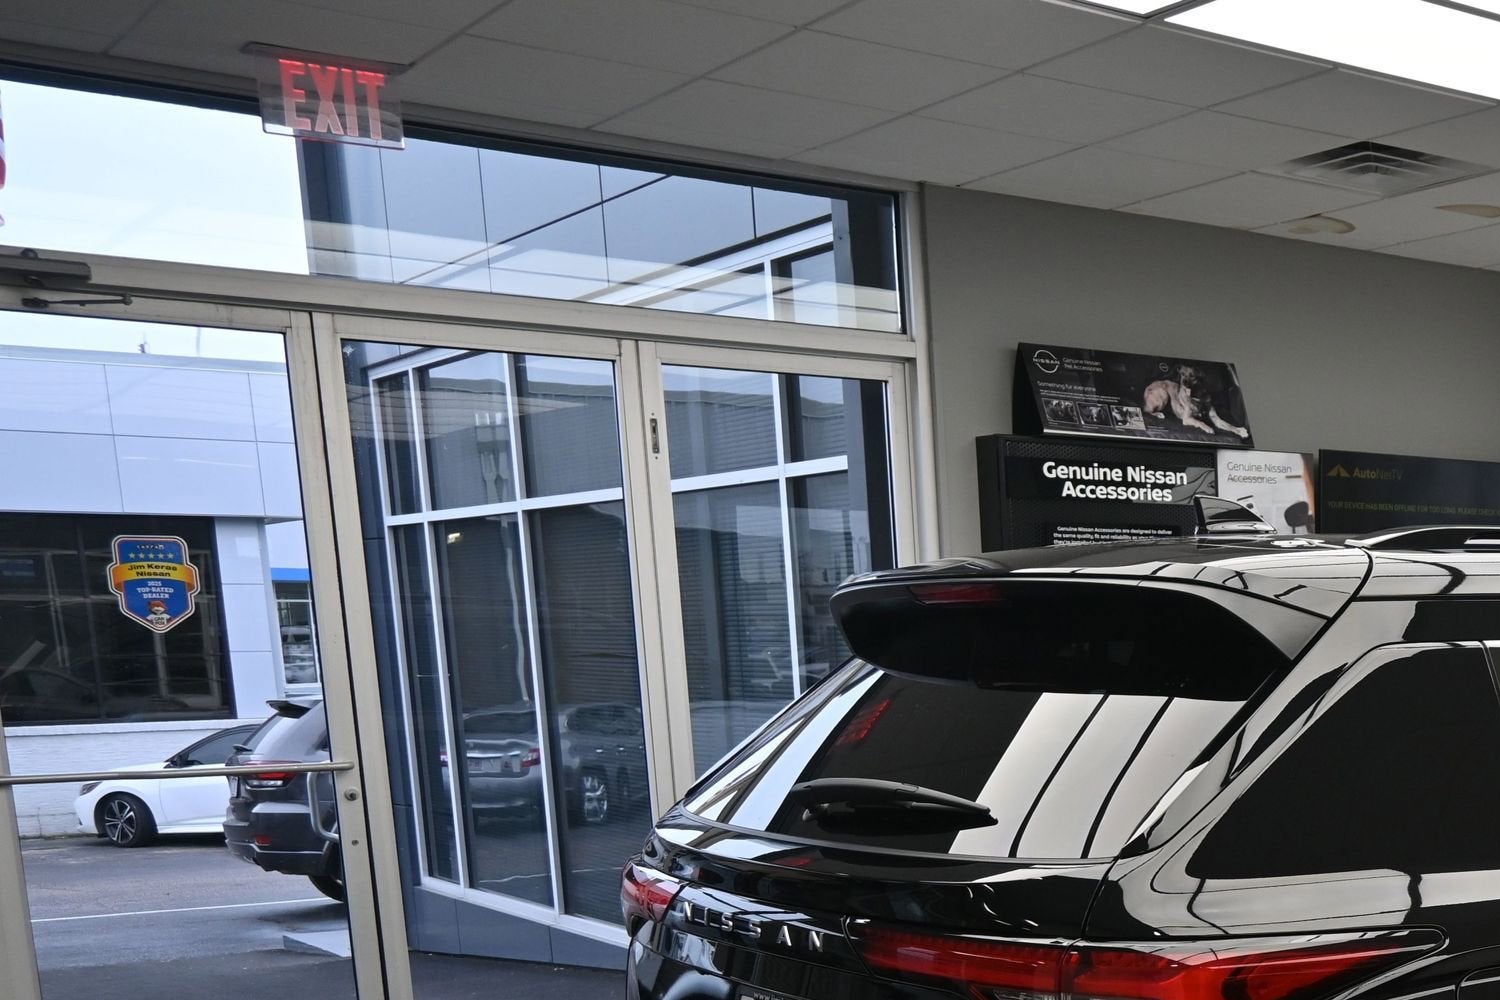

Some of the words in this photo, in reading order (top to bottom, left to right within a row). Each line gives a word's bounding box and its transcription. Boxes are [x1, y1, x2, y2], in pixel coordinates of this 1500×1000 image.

[278, 58, 385, 140] EXIT
[1042, 461, 1123, 482] Genuine
[1126, 465, 1188, 486] Nissan
[1226, 461, 1263, 473] Genuine
[1264, 463, 1292, 474] Nissan
[1227, 473, 1278, 485] Accessories
[1061, 480, 1173, 502] Accessories
[147, 563, 178, 571] Keras
[684, 901, 824, 952] NISSAN
